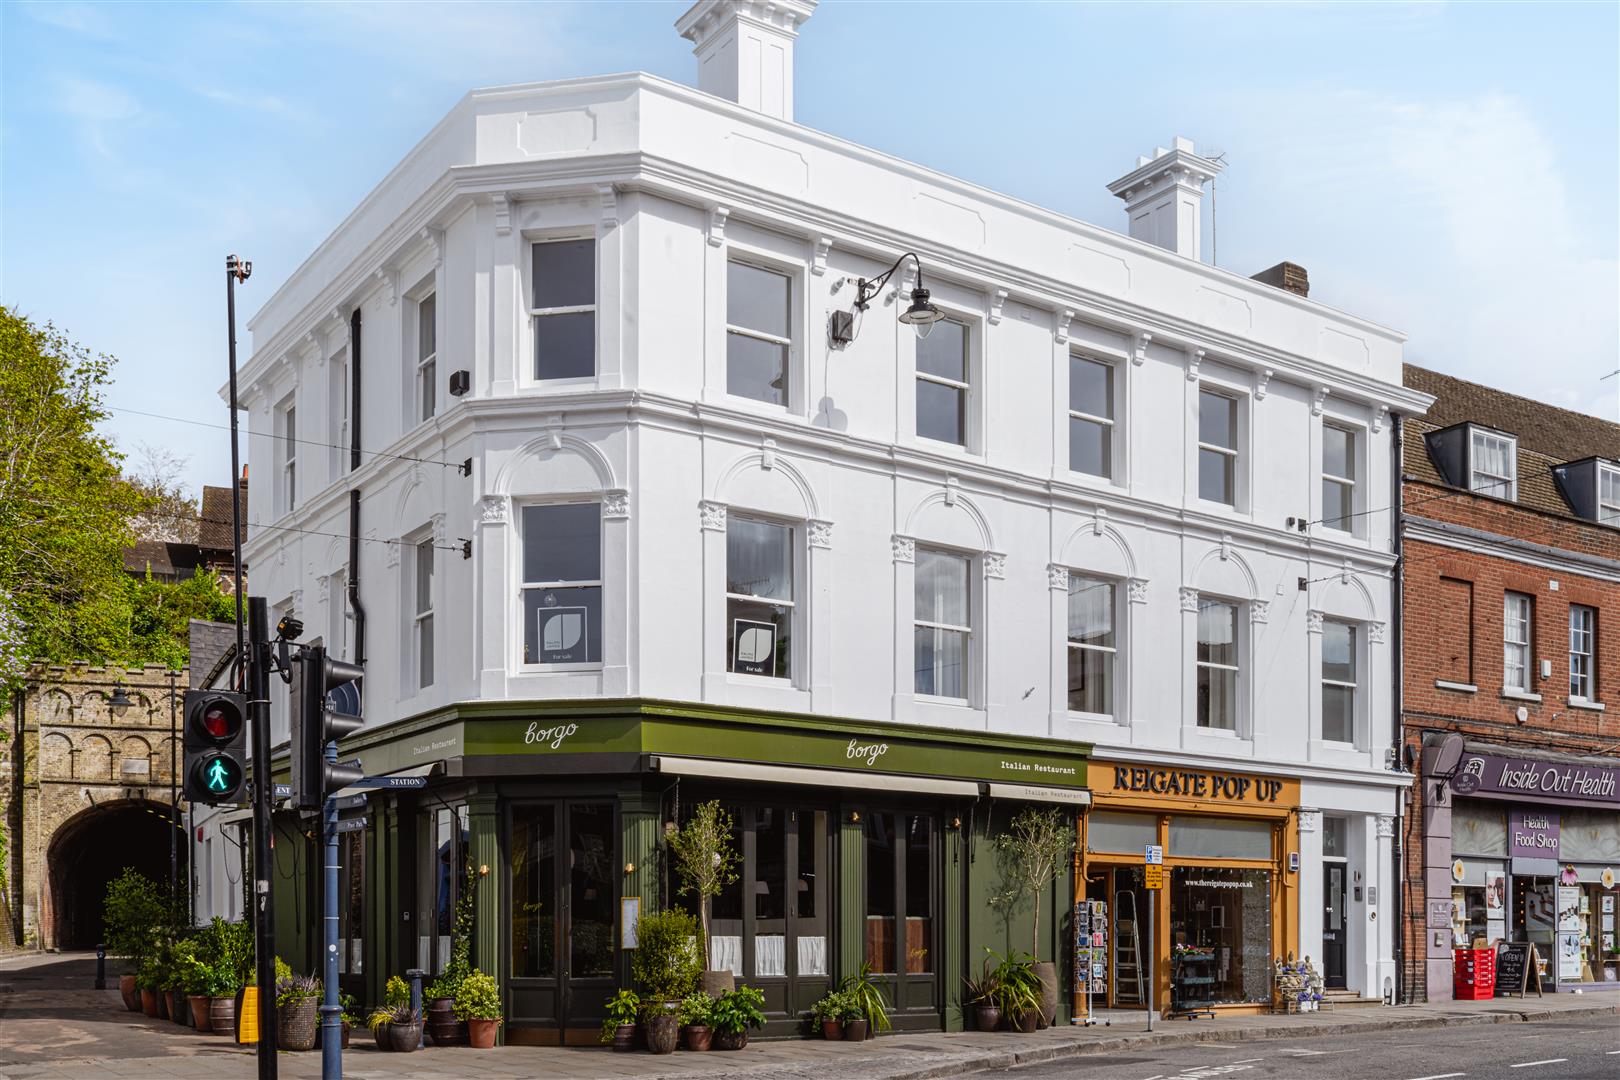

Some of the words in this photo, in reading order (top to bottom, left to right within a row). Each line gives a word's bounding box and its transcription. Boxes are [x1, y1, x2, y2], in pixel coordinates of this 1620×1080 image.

[524, 721, 579, 750] borgo
[846, 738, 888, 766] borgo
[1001, 761, 1030, 771] Italian
[1034, 764, 1076, 774] Restaurant
[1499, 763, 1540, 790] Inside
[1541, 768, 1572, 792] Out
[1570, 770, 1616, 796] Health
[1025, 788, 1048, 796] Italian
[1050, 790, 1082, 799] Restaurant
[1114, 766, 1208, 798] REIGATE
[1211, 774, 1251, 800] POP
[1256, 778, 1283, 802] UP
[1523, 816, 1550, 830] Health
[1515, 832, 1535, 847] Food
[1537, 834, 1558, 852] Shop
